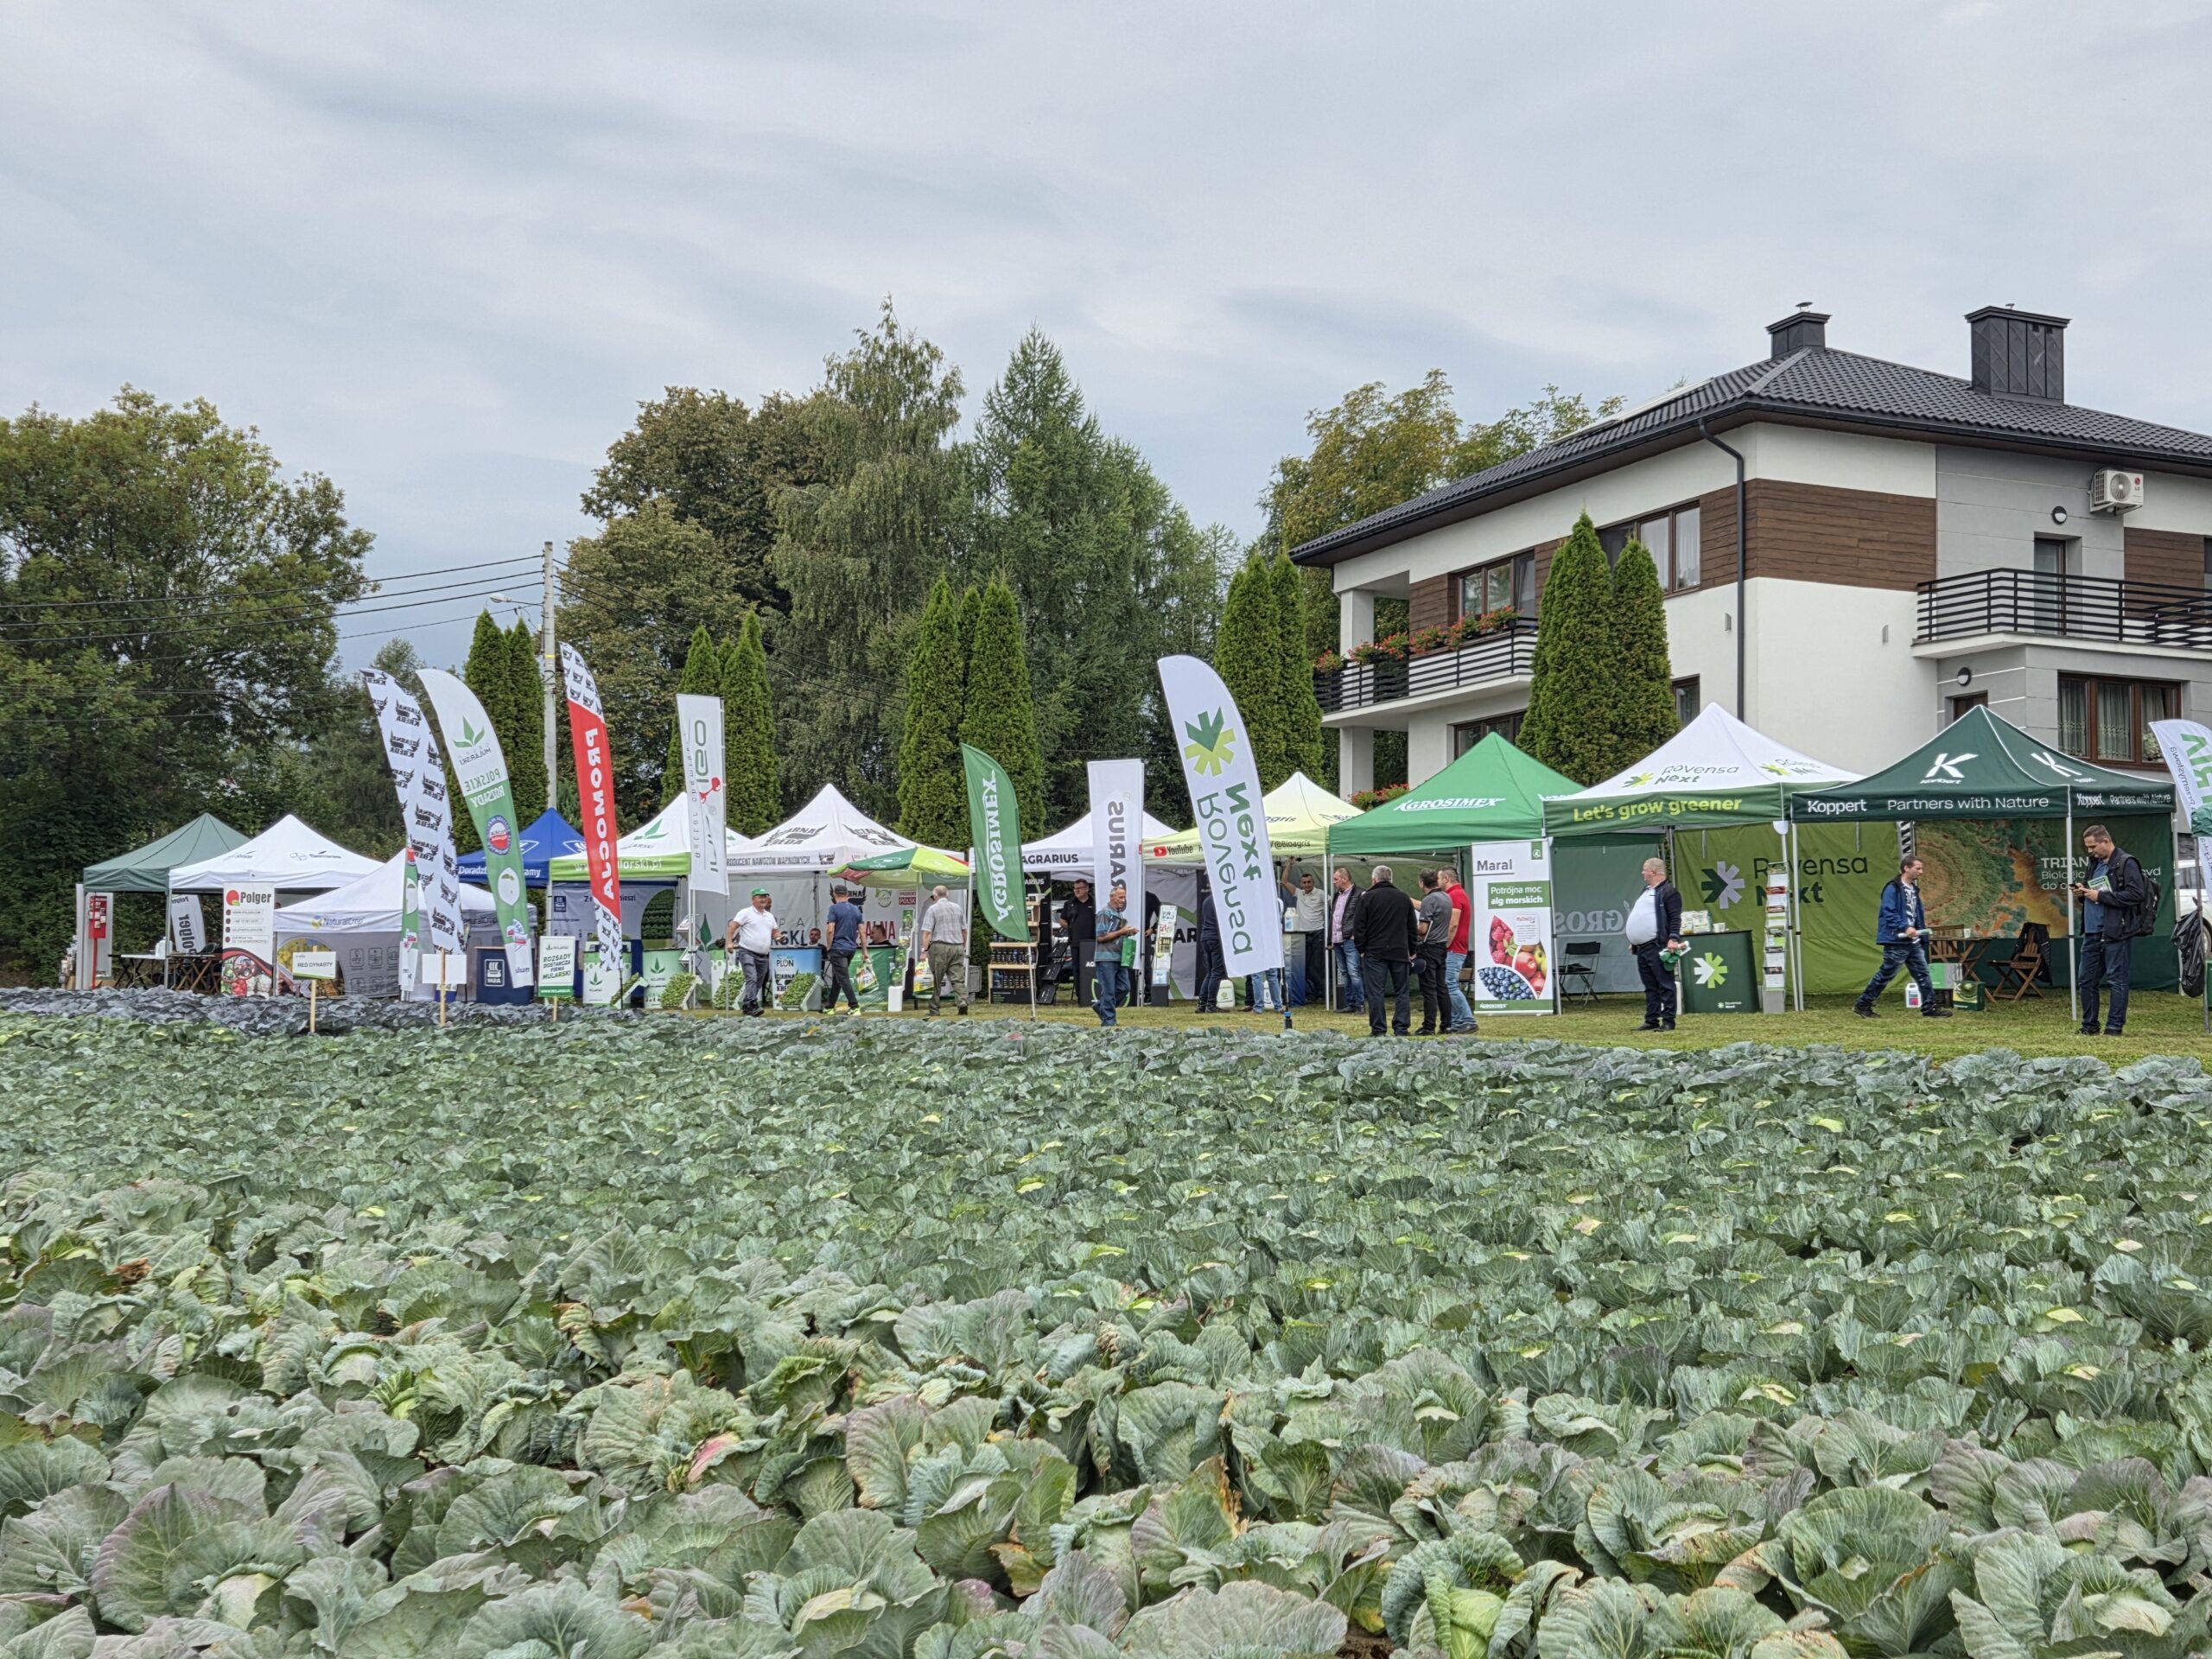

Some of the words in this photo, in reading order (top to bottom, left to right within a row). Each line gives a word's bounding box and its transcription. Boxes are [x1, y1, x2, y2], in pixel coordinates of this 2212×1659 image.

[1662, 765, 1739, 774] Rovensa
[1655, 774, 1700, 785] Next
[1394, 798, 1506, 812] AGROSIMEX
[1573, 804, 1615, 822] Let's
[1618, 802, 1663, 820] grow
[1669, 798, 1743, 817] greener
[1808, 798, 1867, 816] Koppert
[1887, 798, 1954, 811] Partners
[1957, 797, 1991, 810] with
[1995, 796, 2050, 809] Nature
[1166, 844, 1194, 855] YouTube
[1477, 859, 1513, 872] Maral
[1491, 887, 1523, 896] Potrójna
[241, 892, 271, 905] Polger
[1491, 897, 1504, 906] alg
[1505, 895, 1543, 905] morskich
[543, 953, 571, 963] ROZSADY
[543, 970, 571, 979] MULARSKI
